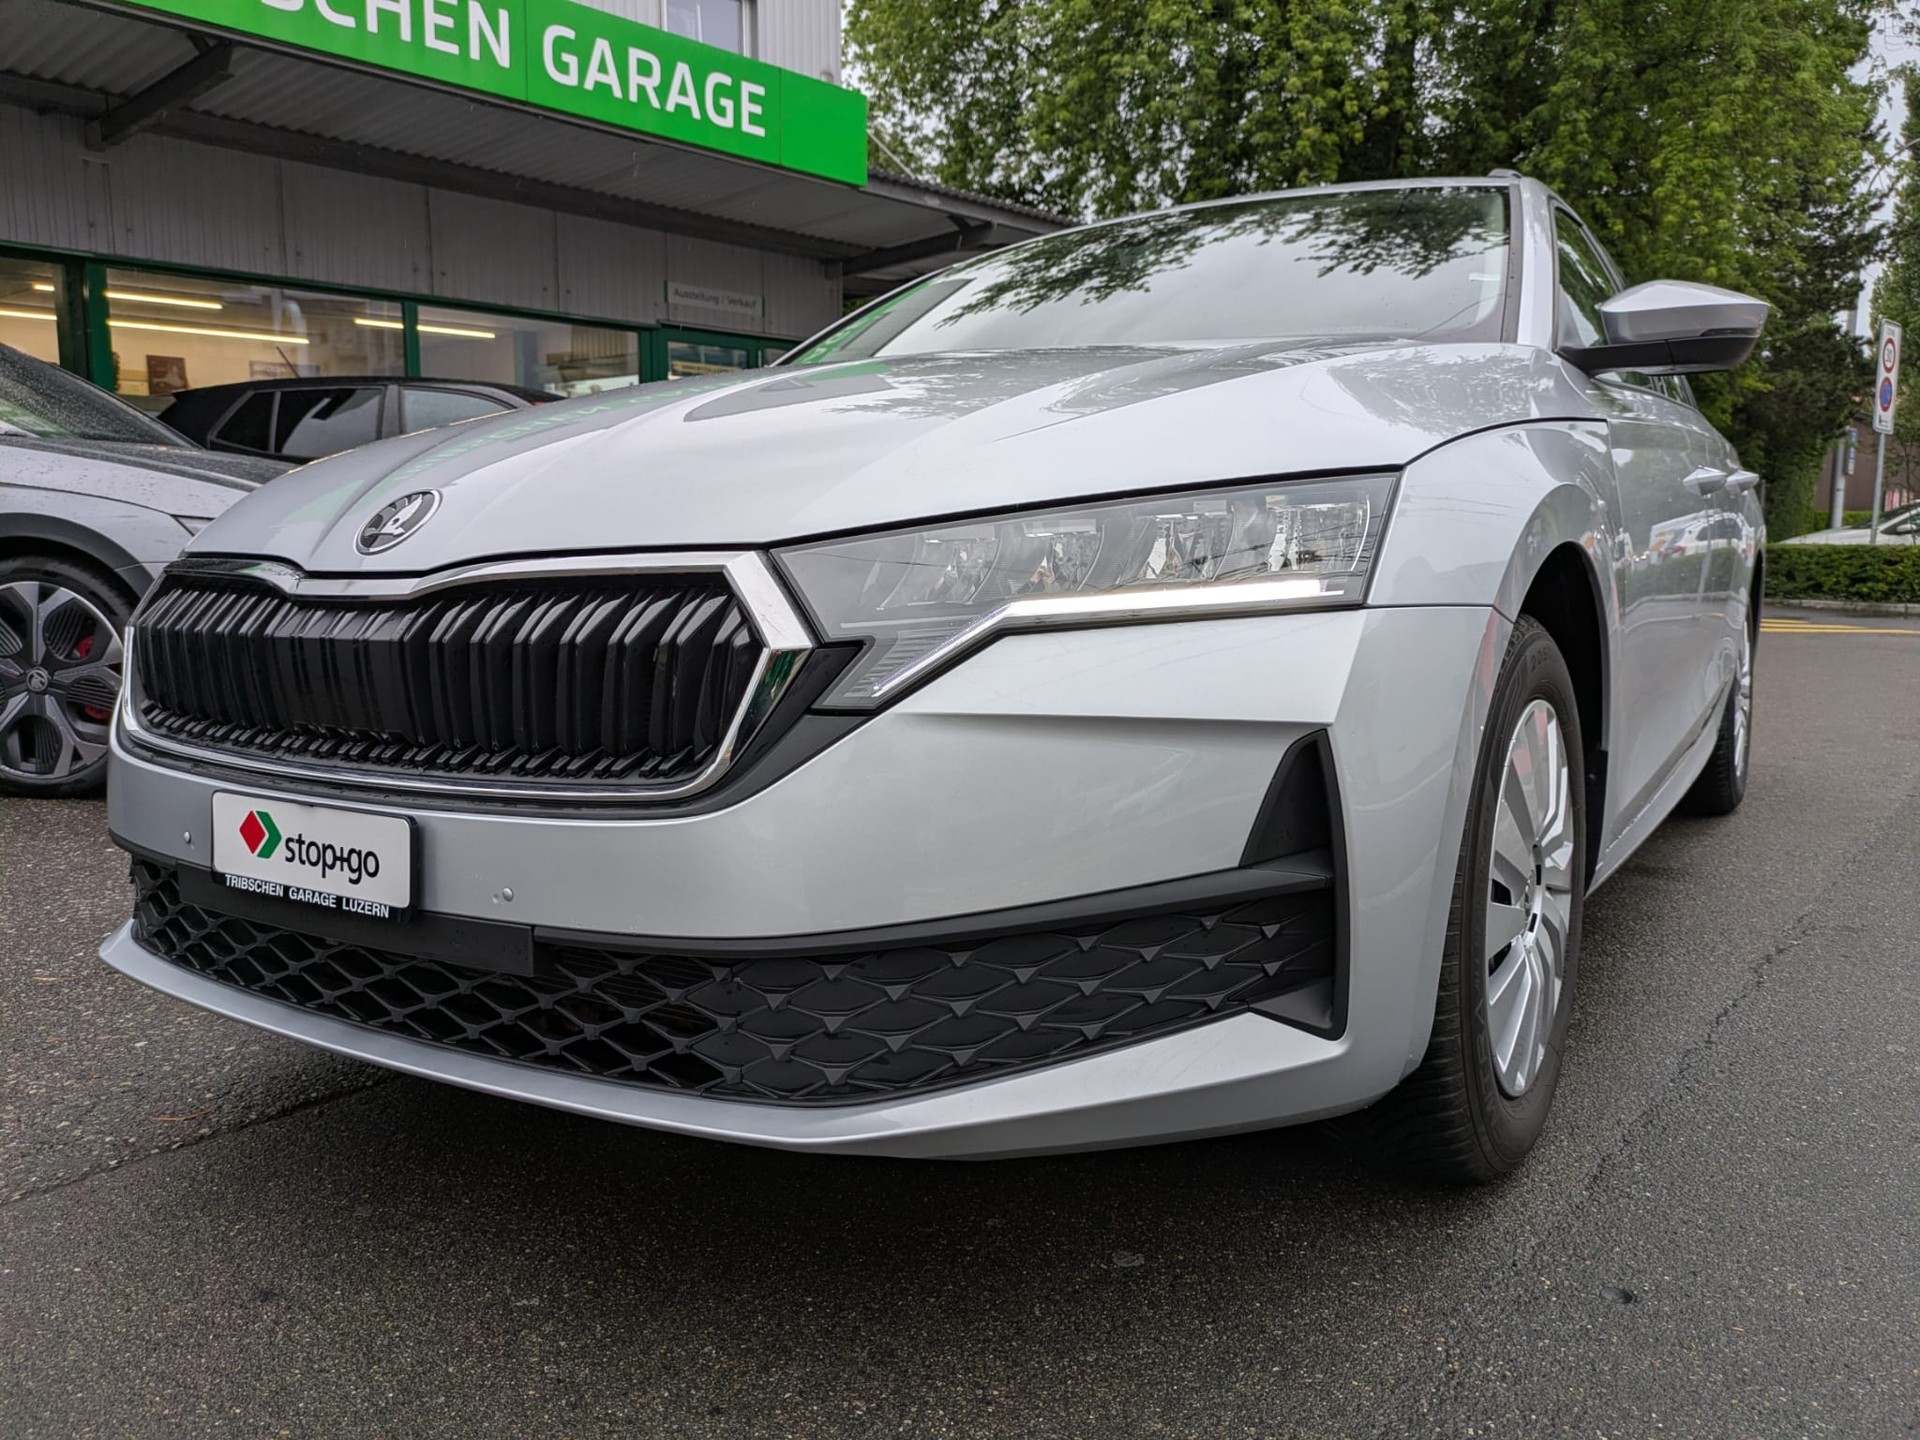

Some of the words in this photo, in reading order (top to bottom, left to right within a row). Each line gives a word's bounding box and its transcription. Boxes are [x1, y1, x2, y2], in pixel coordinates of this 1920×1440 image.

[261, 0, 510, 69] HEN
[542, 24, 766, 137] GARAGE
[284, 833, 380, 885] stop+go
[225, 874, 284, 897] TRIBSCHEN
[289, 886, 337, 908] GARAGE
[342, 897, 390, 919] LUZERN
